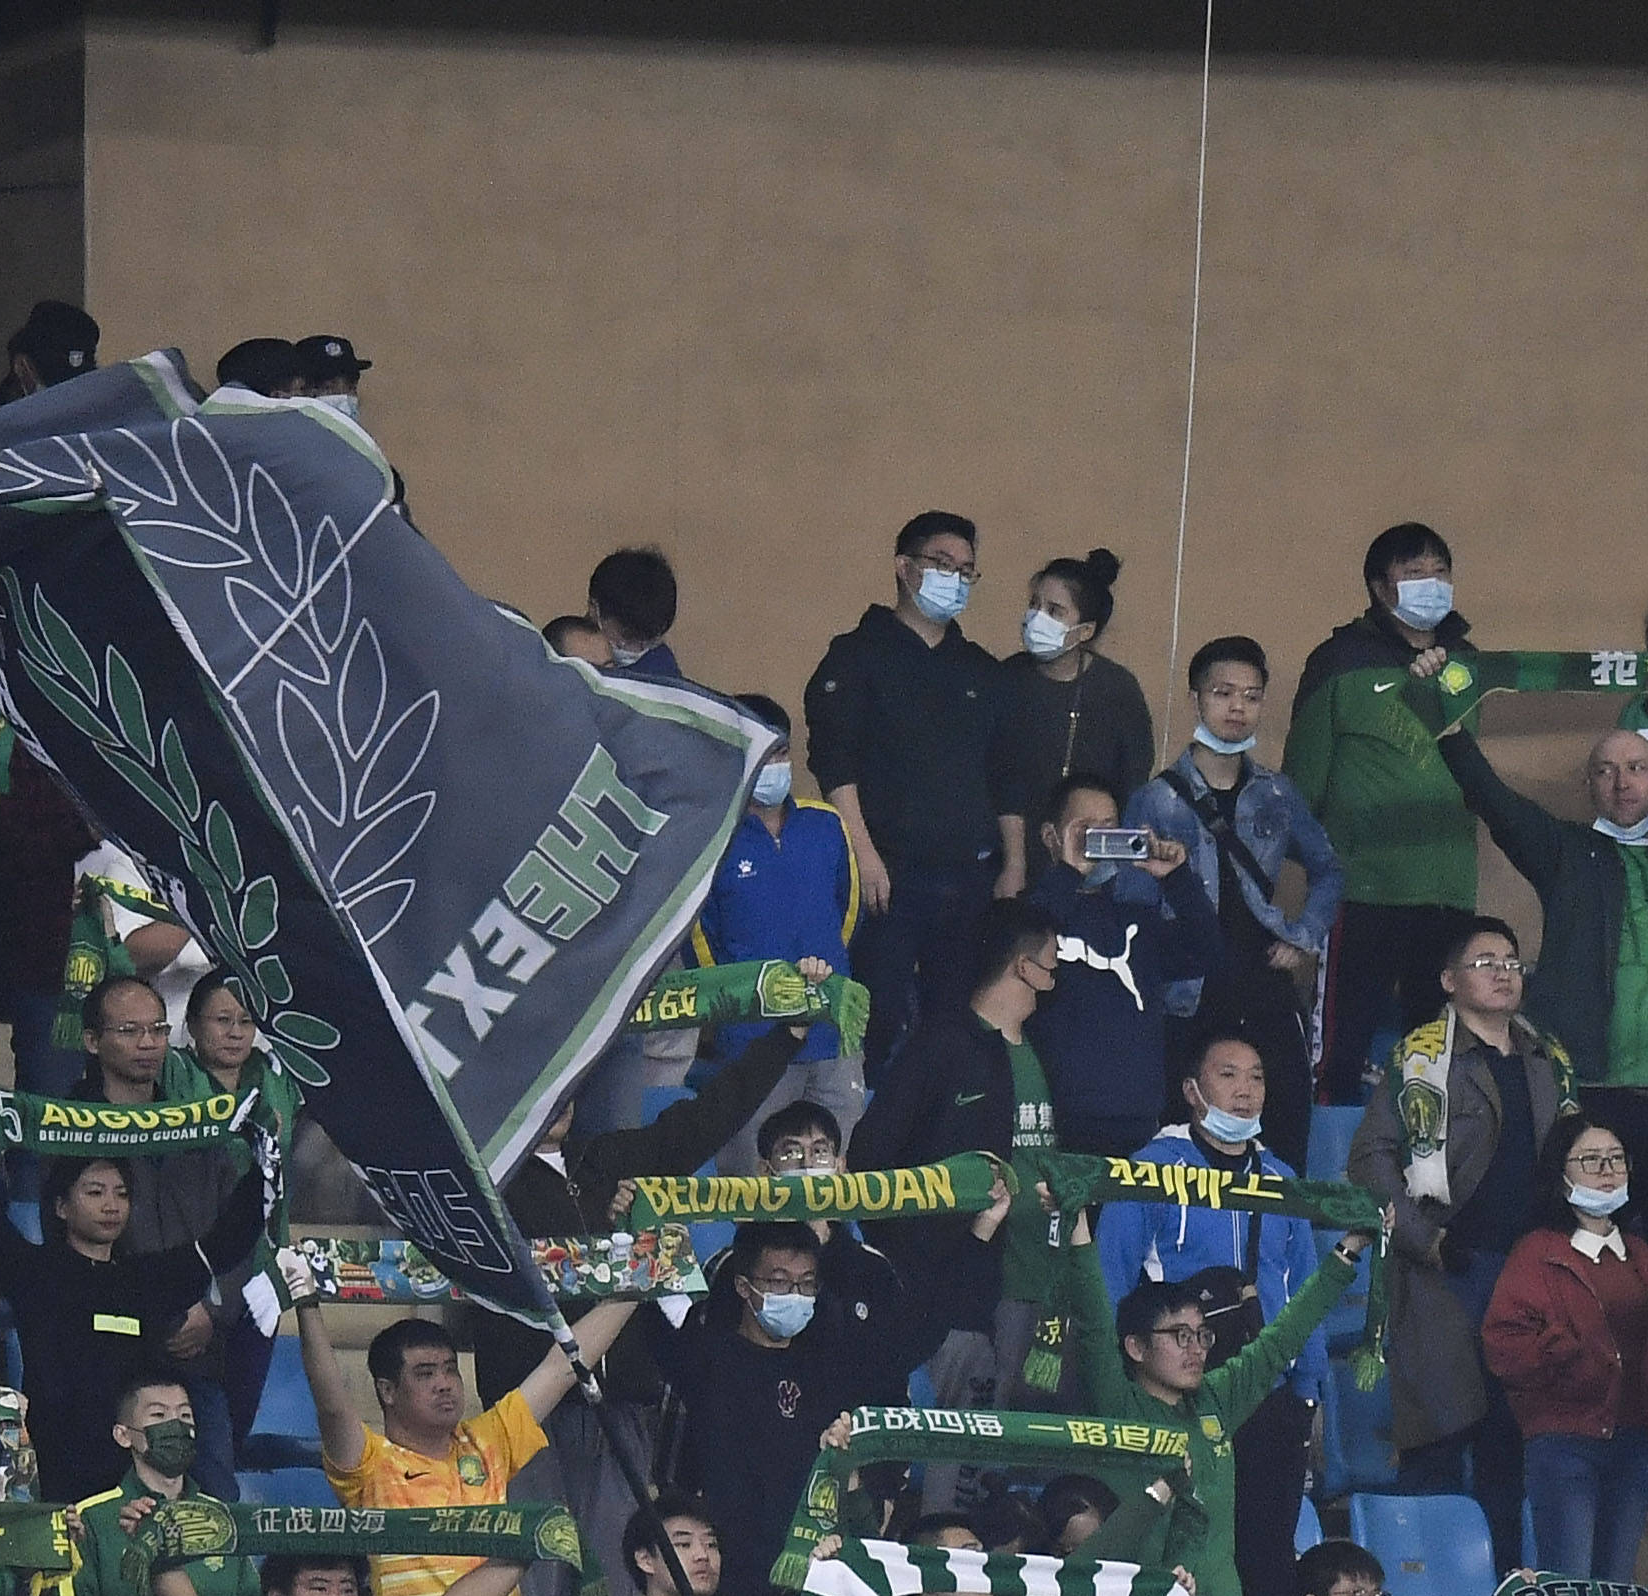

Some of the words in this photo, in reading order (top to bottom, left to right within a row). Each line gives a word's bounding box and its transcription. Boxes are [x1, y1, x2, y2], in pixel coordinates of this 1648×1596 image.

[40, 1093, 236, 1130] AUGUSTO
[39, 1130, 93, 1143] BEIJING
[98, 1131, 148, 1144] SINOBO
[153, 1129, 198, 1142] GUOAN
[203, 1127, 220, 1138] FC
[635, 1176, 792, 1217] BEIJING
[802, 1164, 956, 1213] GUOAN
[253, 1506, 386, 1535] 征战四海
